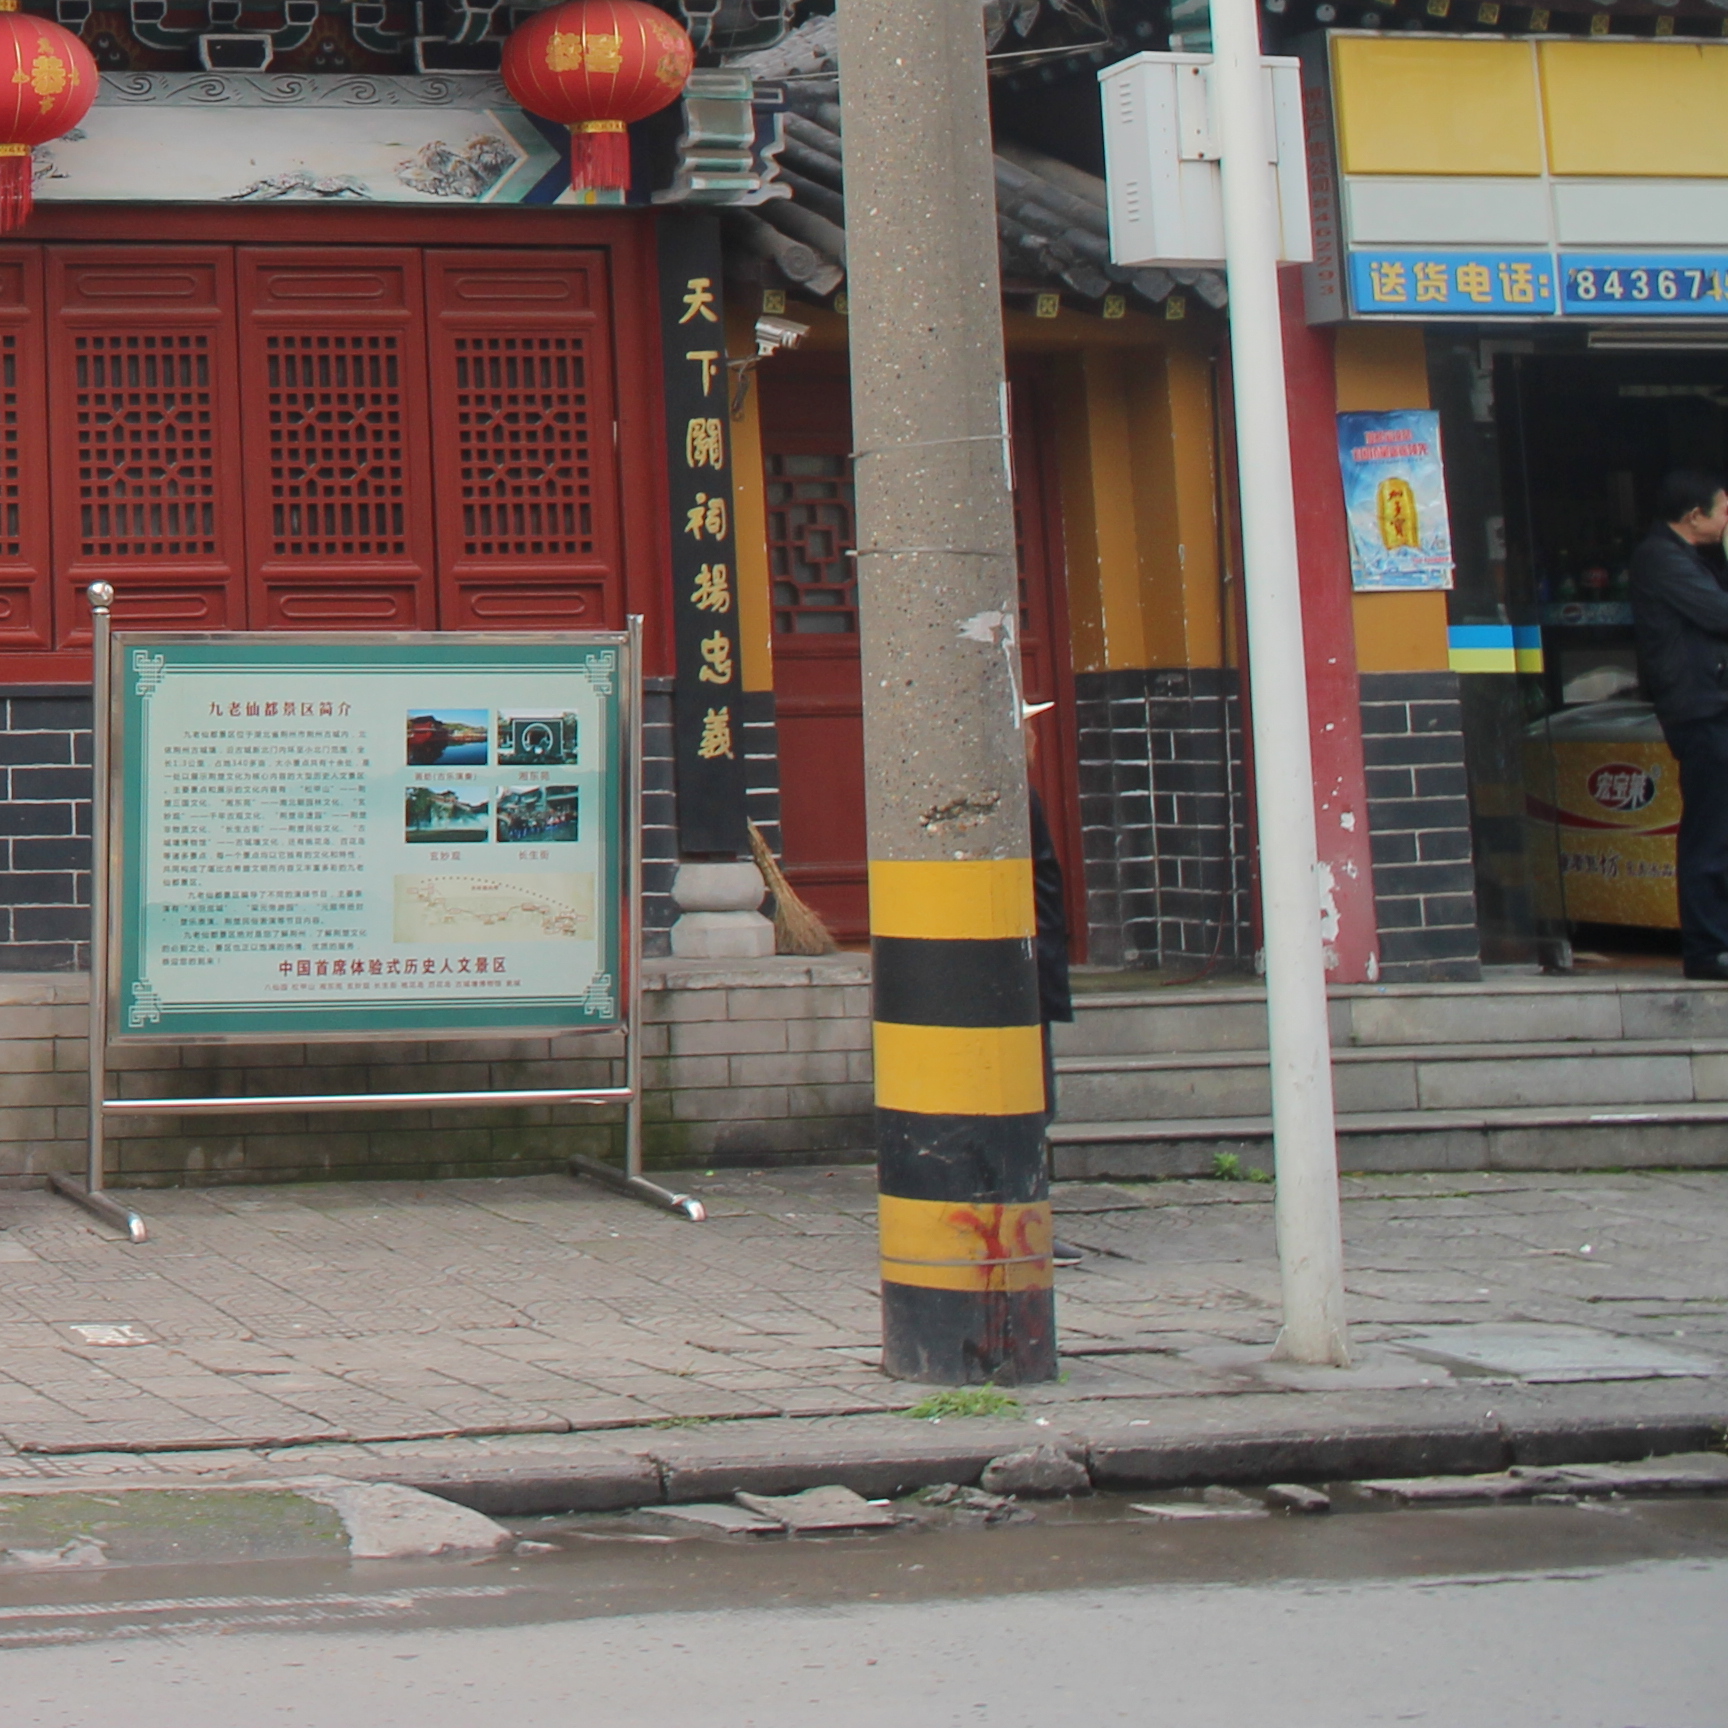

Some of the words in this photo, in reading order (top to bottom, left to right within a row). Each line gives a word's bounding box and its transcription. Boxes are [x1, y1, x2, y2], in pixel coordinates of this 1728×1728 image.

[209, 701, 352, 717] 九老仙都景区简介
[279, 956, 507, 977] 中国首席体验式历史人文景区
